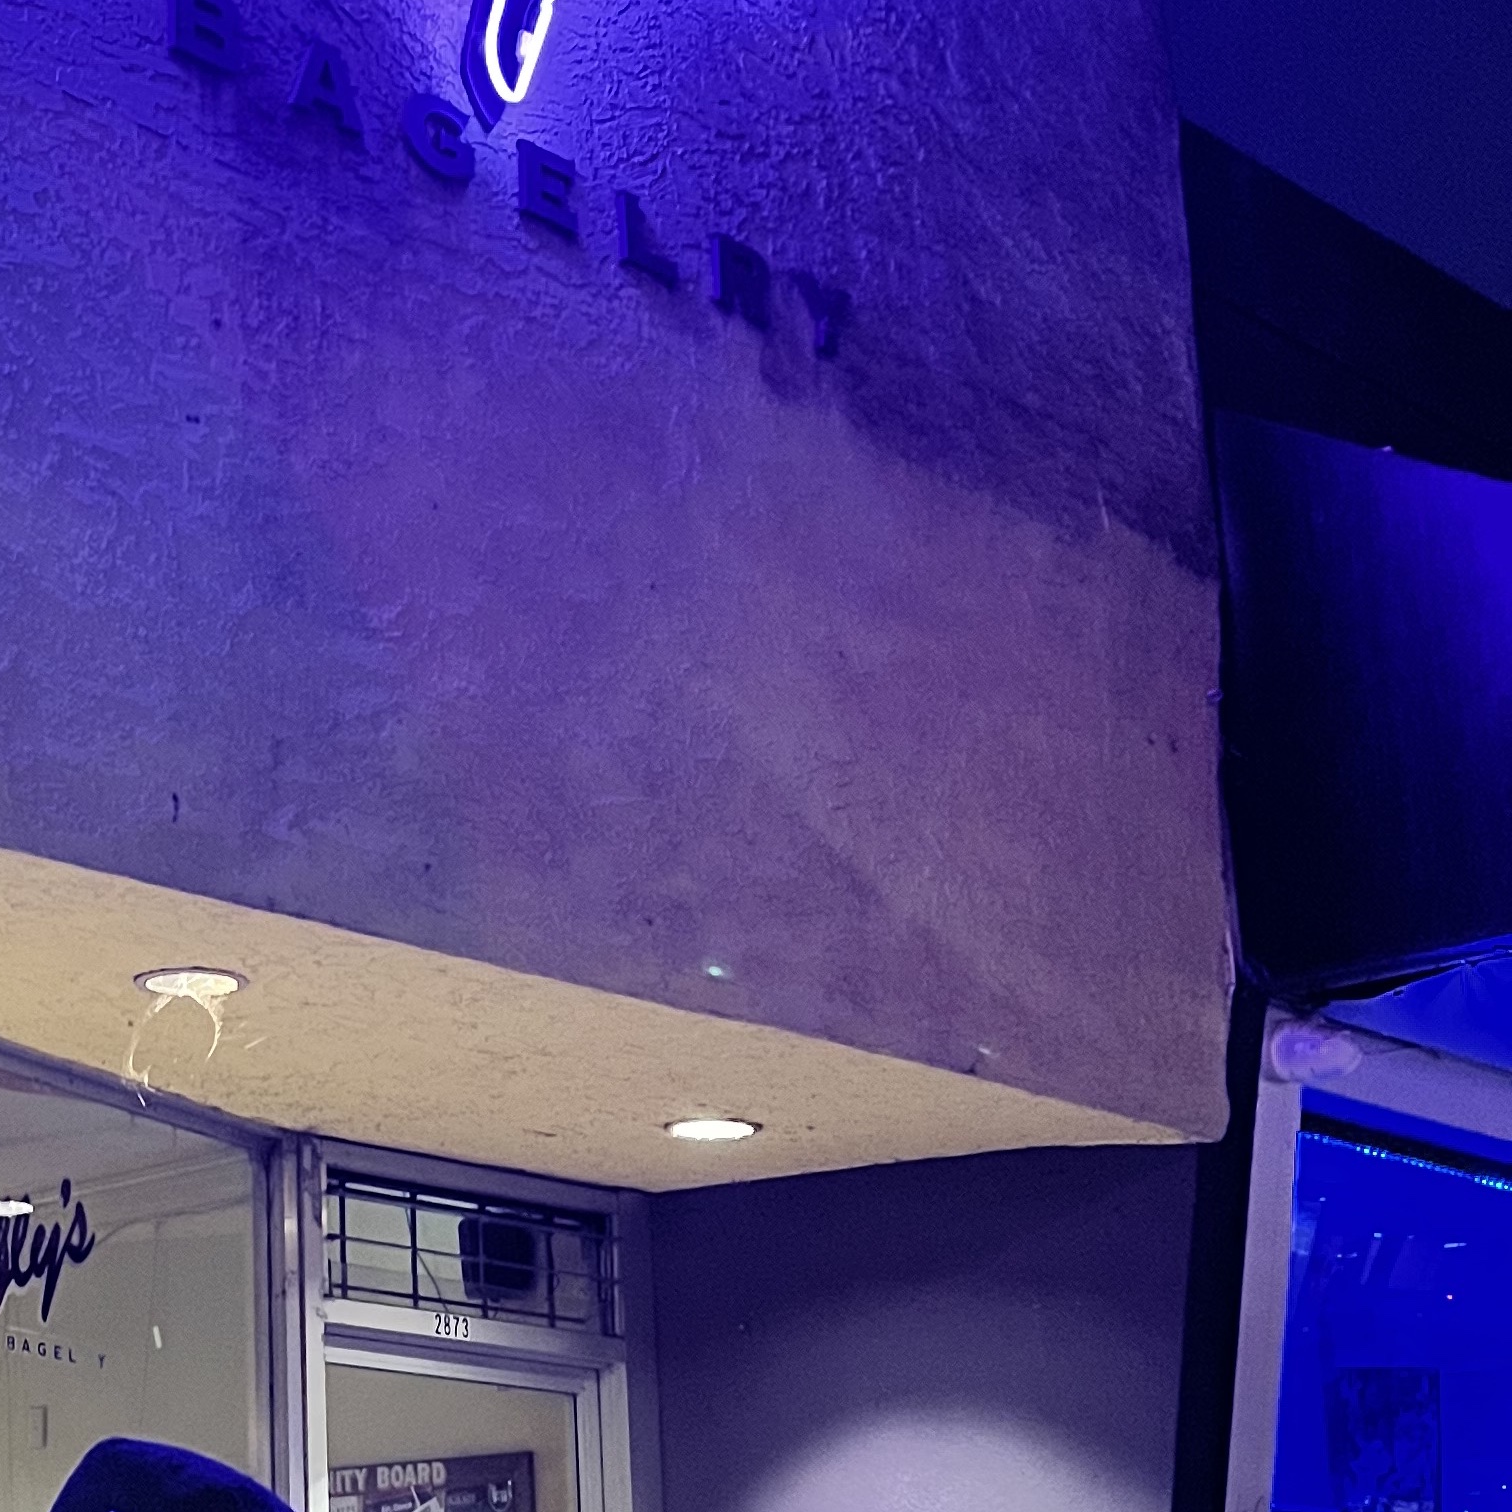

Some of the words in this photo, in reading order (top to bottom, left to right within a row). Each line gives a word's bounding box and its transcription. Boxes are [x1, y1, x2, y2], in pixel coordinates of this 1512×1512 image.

[168, 0, 852, 358] BAGELRY
[434, 1313, 470, 1338] 2873
[376, 1461, 448, 1488] BOARD
